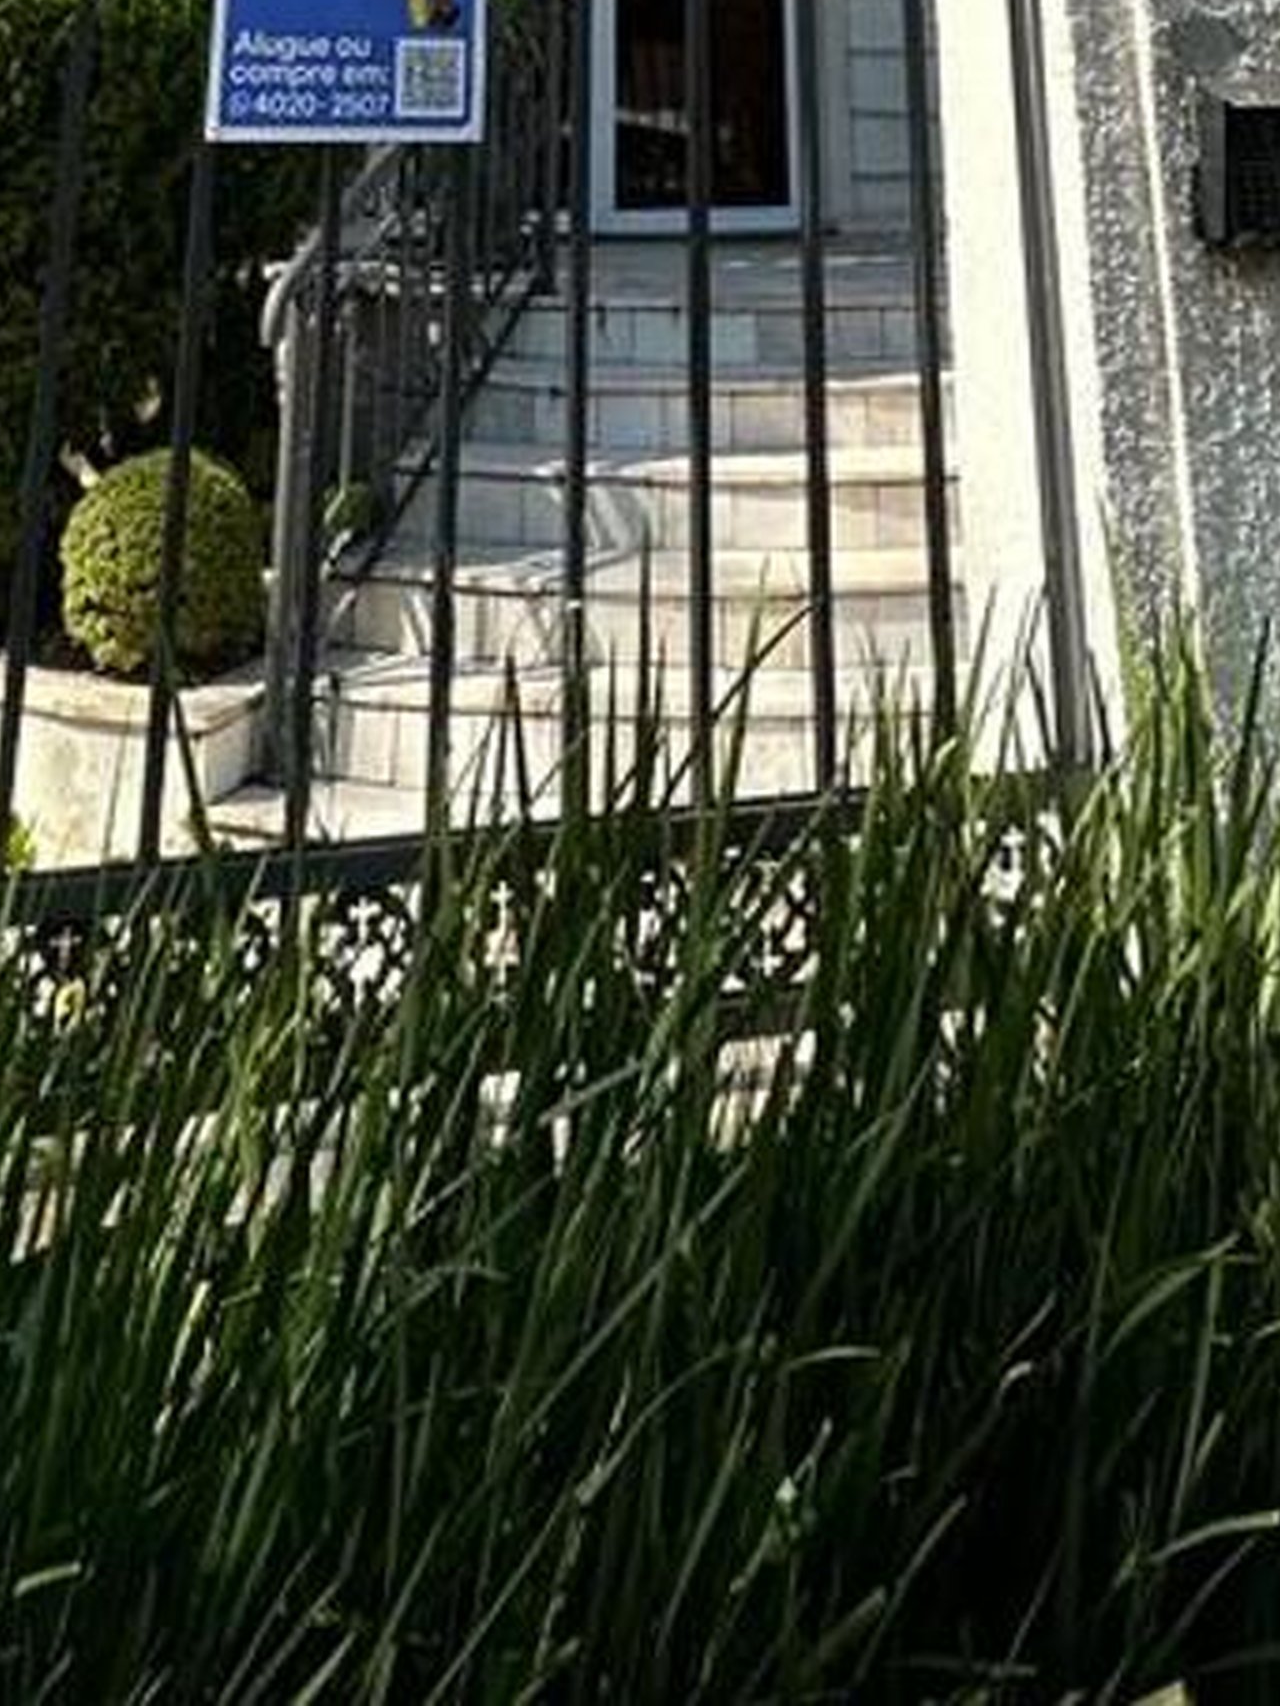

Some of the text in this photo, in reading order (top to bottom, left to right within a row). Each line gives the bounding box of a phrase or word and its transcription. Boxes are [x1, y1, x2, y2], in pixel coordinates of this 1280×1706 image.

[232, 31, 372, 62] Alugue ou
[229, 65, 337, 88] compre
